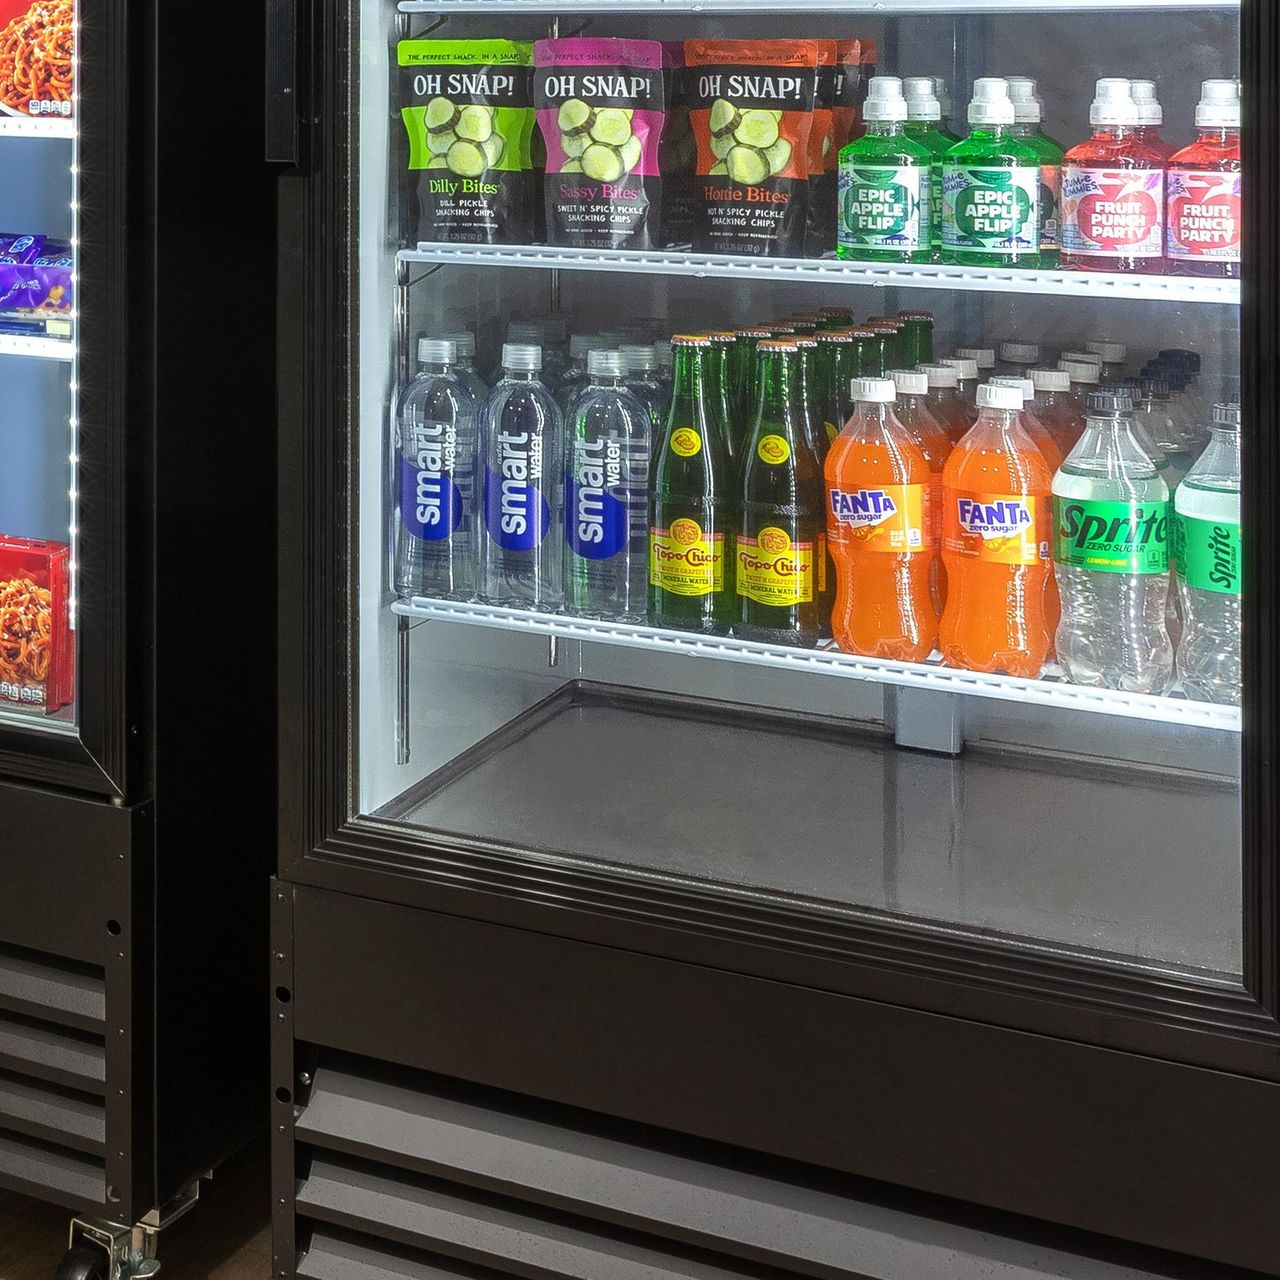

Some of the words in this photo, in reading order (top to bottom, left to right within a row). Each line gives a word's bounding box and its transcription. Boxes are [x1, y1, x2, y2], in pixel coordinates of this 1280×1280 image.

[413, 77, 440, 96] OH
[447, 74, 514, 96] SNAP!
[545, 77, 575, 97] OH
[582, 76, 651, 99] SNAP!
[698, 77, 720, 99] OH
[729, 77, 802, 99] SNAP!
[429, 178, 458, 195] Dilly
[462, 178, 498, 195] Bites
[559, 183, 597, 201] Sassy
[601, 183, 639, 200] Bites
[704, 186, 743, 203] Hottie
[746, 187, 789, 204] Bites
[858, 189, 896, 203] EPIC
[974, 190, 1013, 203] EPIC
[459, 199, 488, 208] PICKLE
[590, 205, 615, 214] SPICY
[850, 203, 904, 216] APPLE
[965, 204, 1021, 217] APPLE
[1095, 202, 1141, 214] FRUIT
[1184, 205, 1230, 216] FRUIT
[727, 209, 753, 218] SPICY
[754, 209, 785, 219] PICKLE
[1091, 214, 1146, 225] PUNCH
[858, 216, 892, 230] FLIP
[974, 218, 1011, 233] FLIP
[1180, 218, 1234, 229] PUNCH
[1092, 226, 1145, 239] PARTY
[1181, 230, 1234, 242] PARTY
[444, 424, 457, 471] water
[530, 432, 543, 480] water
[607, 439, 620, 487] water
[415, 424, 443, 526] smart
[500, 430, 528, 535] smart
[578, 438, 605, 544] smart
[830, 489, 896, 516] FANTA
[859, 511, 882, 524] sugar
[959, 499, 1030, 525] FANTA
[1060, 504, 1168, 550] Sprite
[1087, 542, 1111, 552] ZERO
[1113, 544, 1145, 553] SUGAR
[1208, 526, 1232, 589] Sprite
